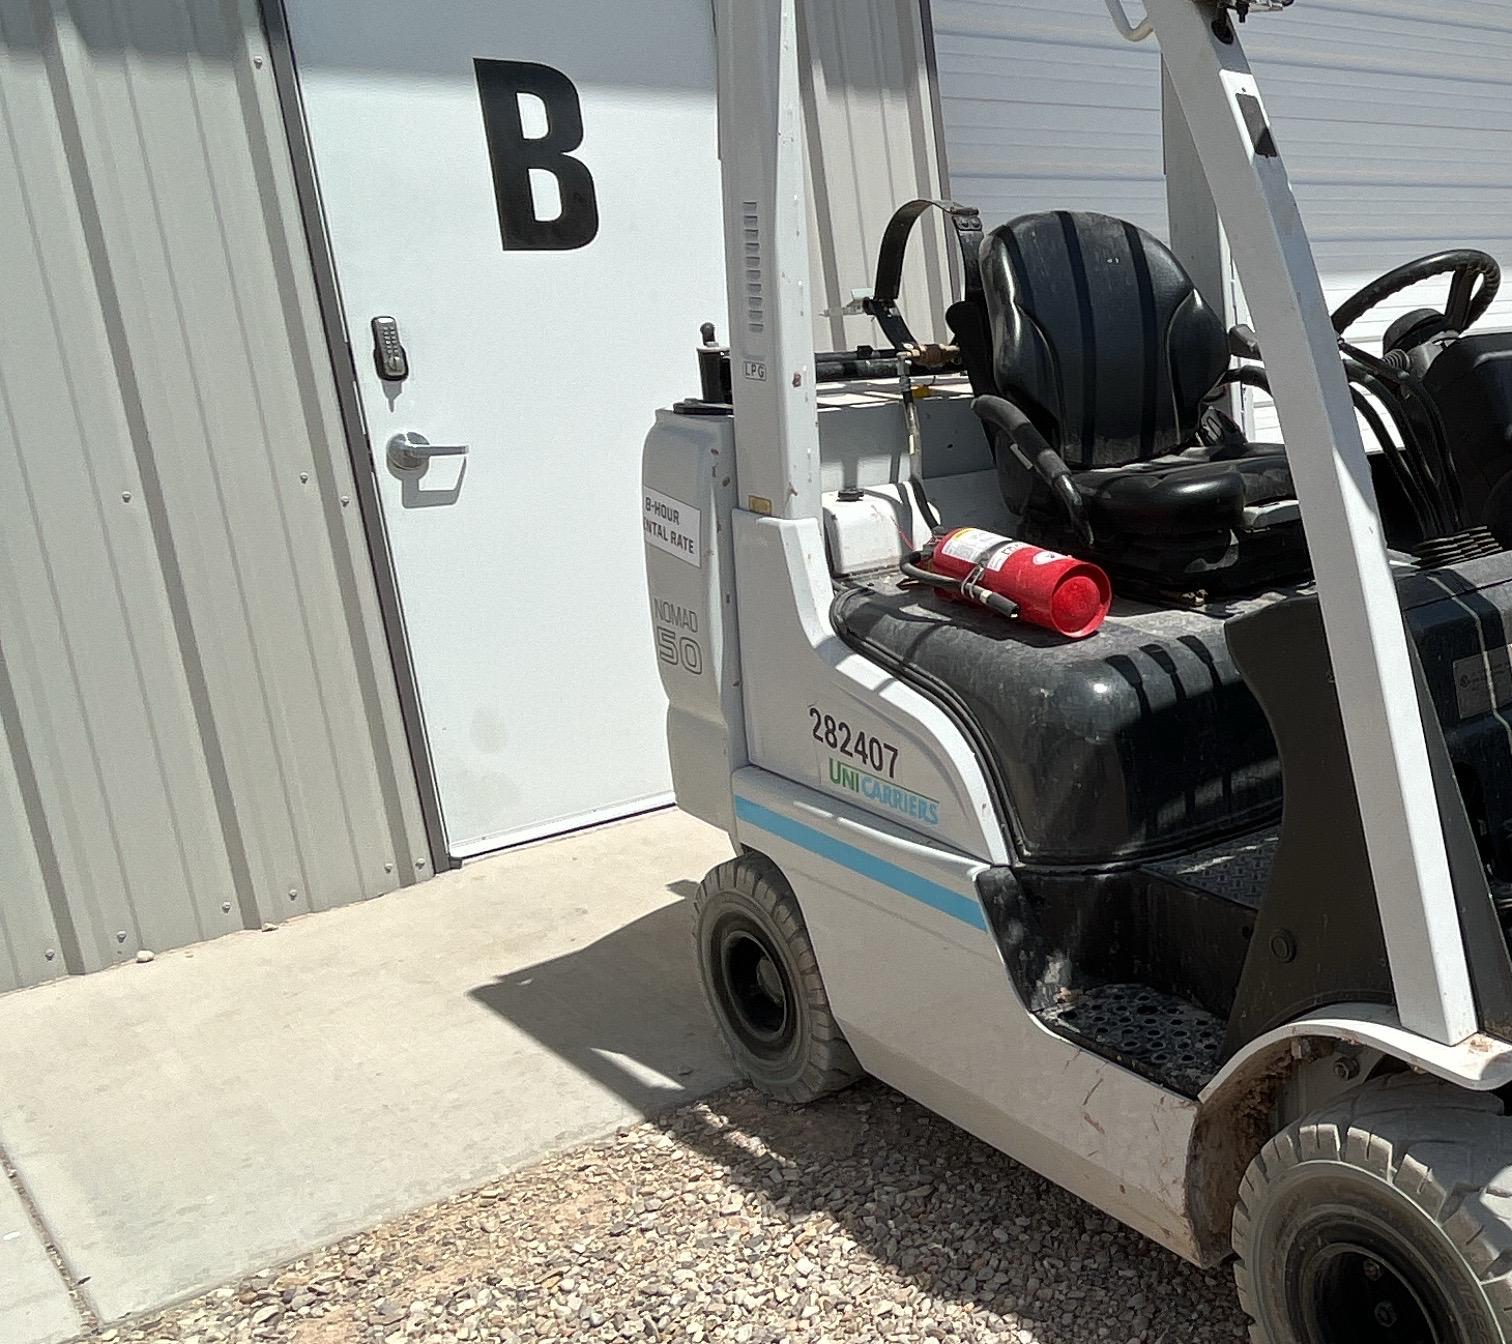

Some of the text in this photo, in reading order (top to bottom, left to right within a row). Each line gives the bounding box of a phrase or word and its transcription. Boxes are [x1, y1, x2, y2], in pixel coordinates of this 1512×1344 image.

[472, 57, 600, 250] B
[670, 530, 695, 555] RATE
[654, 597, 698, 633] NOMAD
[656, 626, 703, 675] 50
[809, 707, 899, 779] 282407
